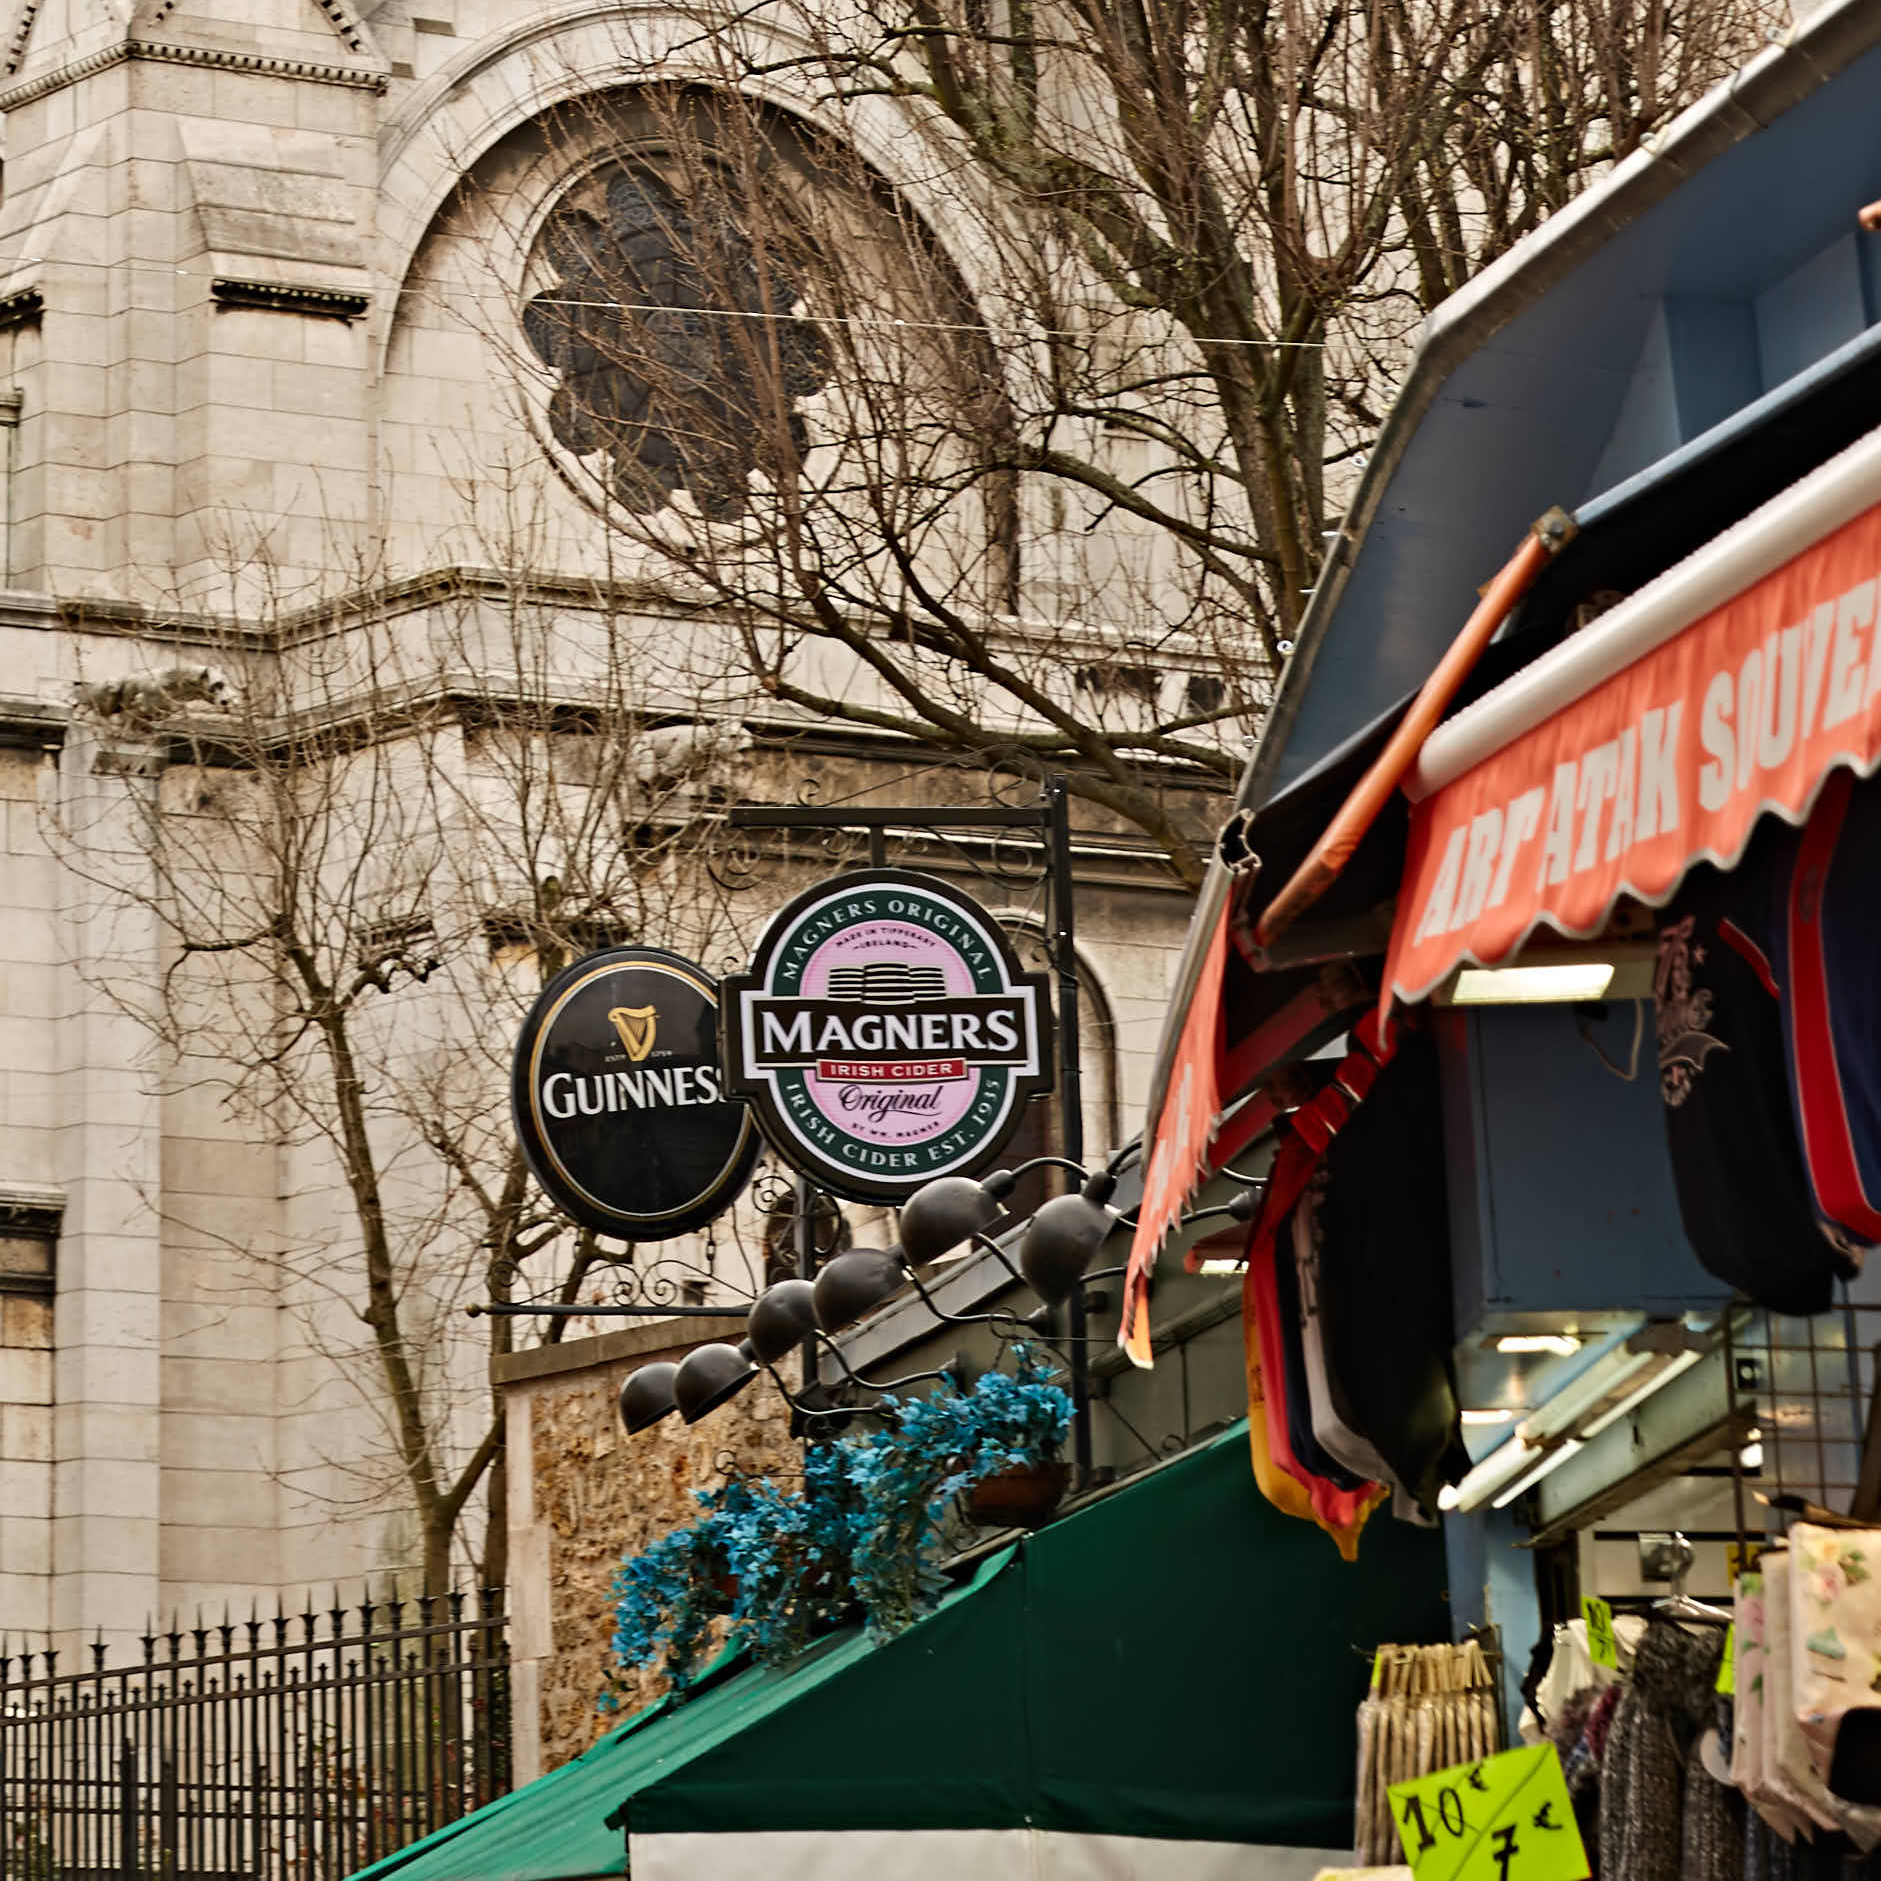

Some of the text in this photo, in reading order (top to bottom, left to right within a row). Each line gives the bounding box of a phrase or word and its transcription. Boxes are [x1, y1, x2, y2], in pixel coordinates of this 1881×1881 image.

[1699, 571, 1881, 813] SOUVE
[782, 899, 992, 980] MAGNERS ORIGINAL
[761, 1009, 1020, 1054] MAGNERS
[830, 1062, 954, 1078] IRISH CIDER
[785, 1078, 1001, 1167] IRISH CIDER EST. 1935
[838, 1084, 945, 1123] Original
